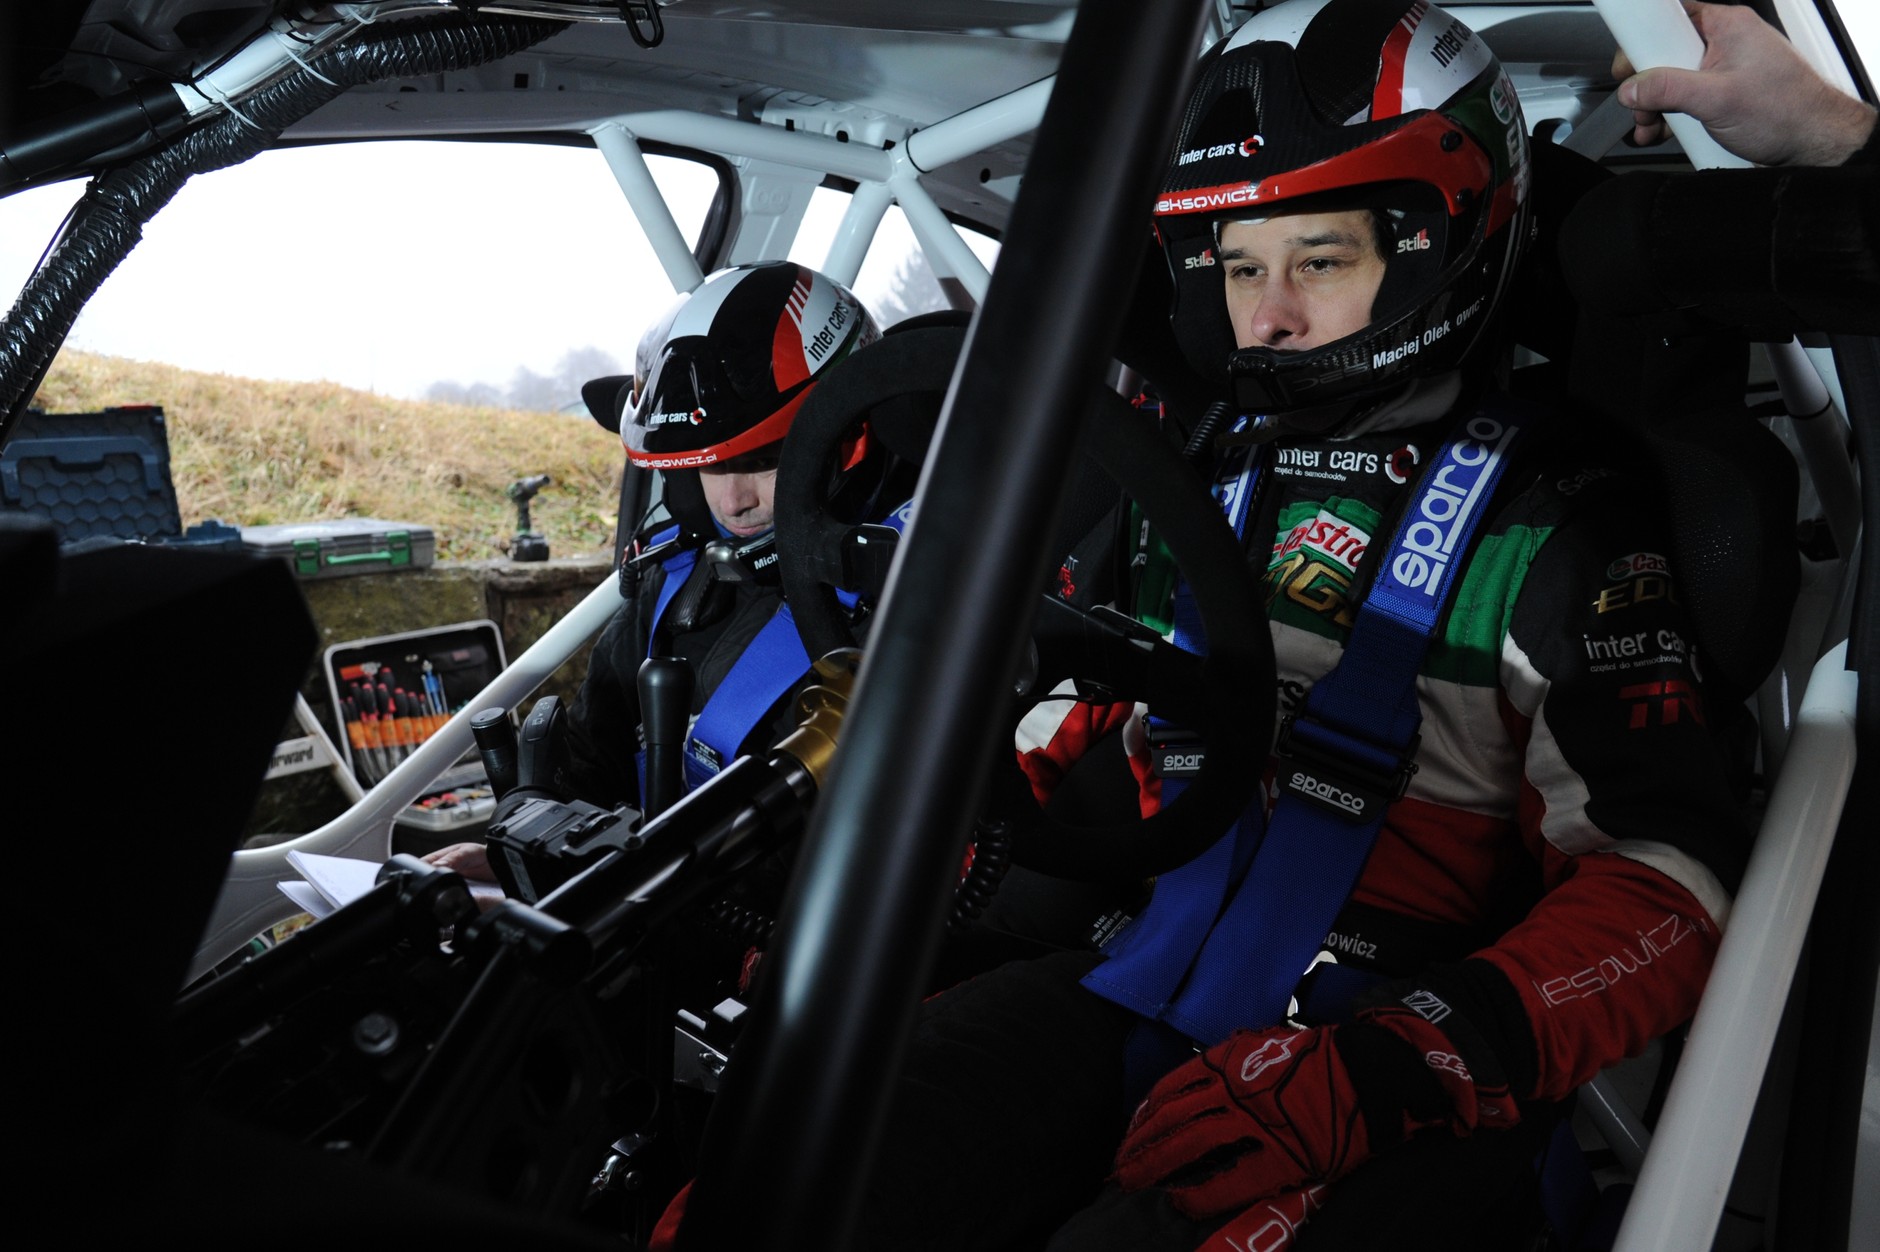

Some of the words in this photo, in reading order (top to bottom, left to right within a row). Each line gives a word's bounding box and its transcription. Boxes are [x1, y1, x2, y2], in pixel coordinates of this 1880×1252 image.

[1179, 147, 1207, 166] inter
[1207, 143, 1236, 159] cars
[804, 325, 836, 362] inter
[828, 302, 849, 331] cars
[1373, 336, 1419, 369] Maciej
[650, 412, 668, 425] inter
[668, 411, 688, 423] cars
[1274, 441, 1323, 468] inter
[1329, 450, 1379, 474] cars
[1392, 417, 1506, 590] sparco
[1632, 553, 1667, 572] Cas
[1583, 632, 1648, 660] inter
[1163, 754, 1205, 770] spar
[1290, 772, 1365, 813] sparco
[1323, 931, 1378, 960] owicz
